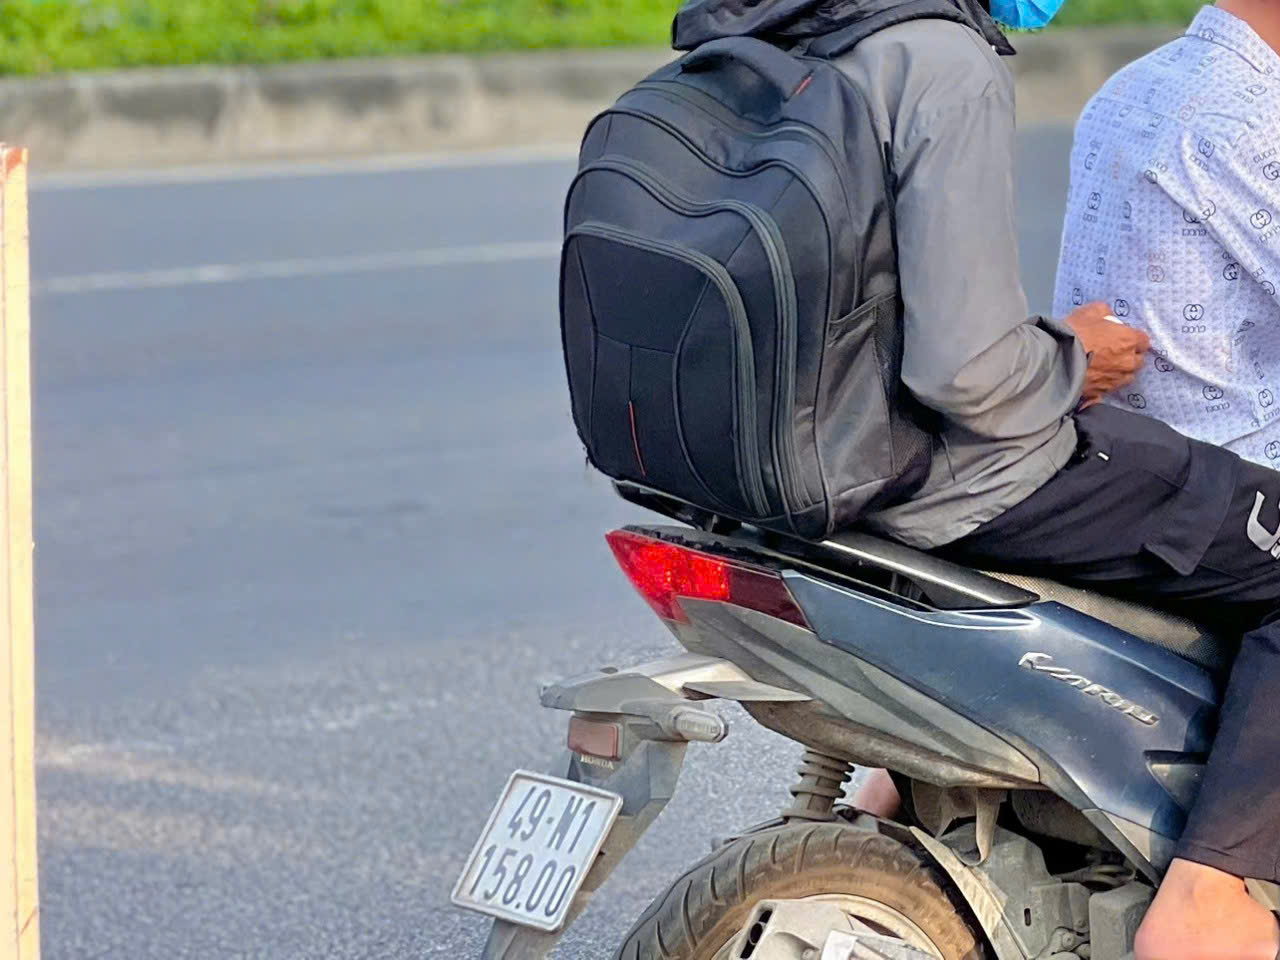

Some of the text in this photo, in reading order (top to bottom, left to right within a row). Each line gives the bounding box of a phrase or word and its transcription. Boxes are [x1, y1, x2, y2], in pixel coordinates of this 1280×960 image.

[1182, 228, 1207, 237] GUCCI
[1181, 324, 1207, 334] GUCCI
[469, 844, 576, 917] 158.00
